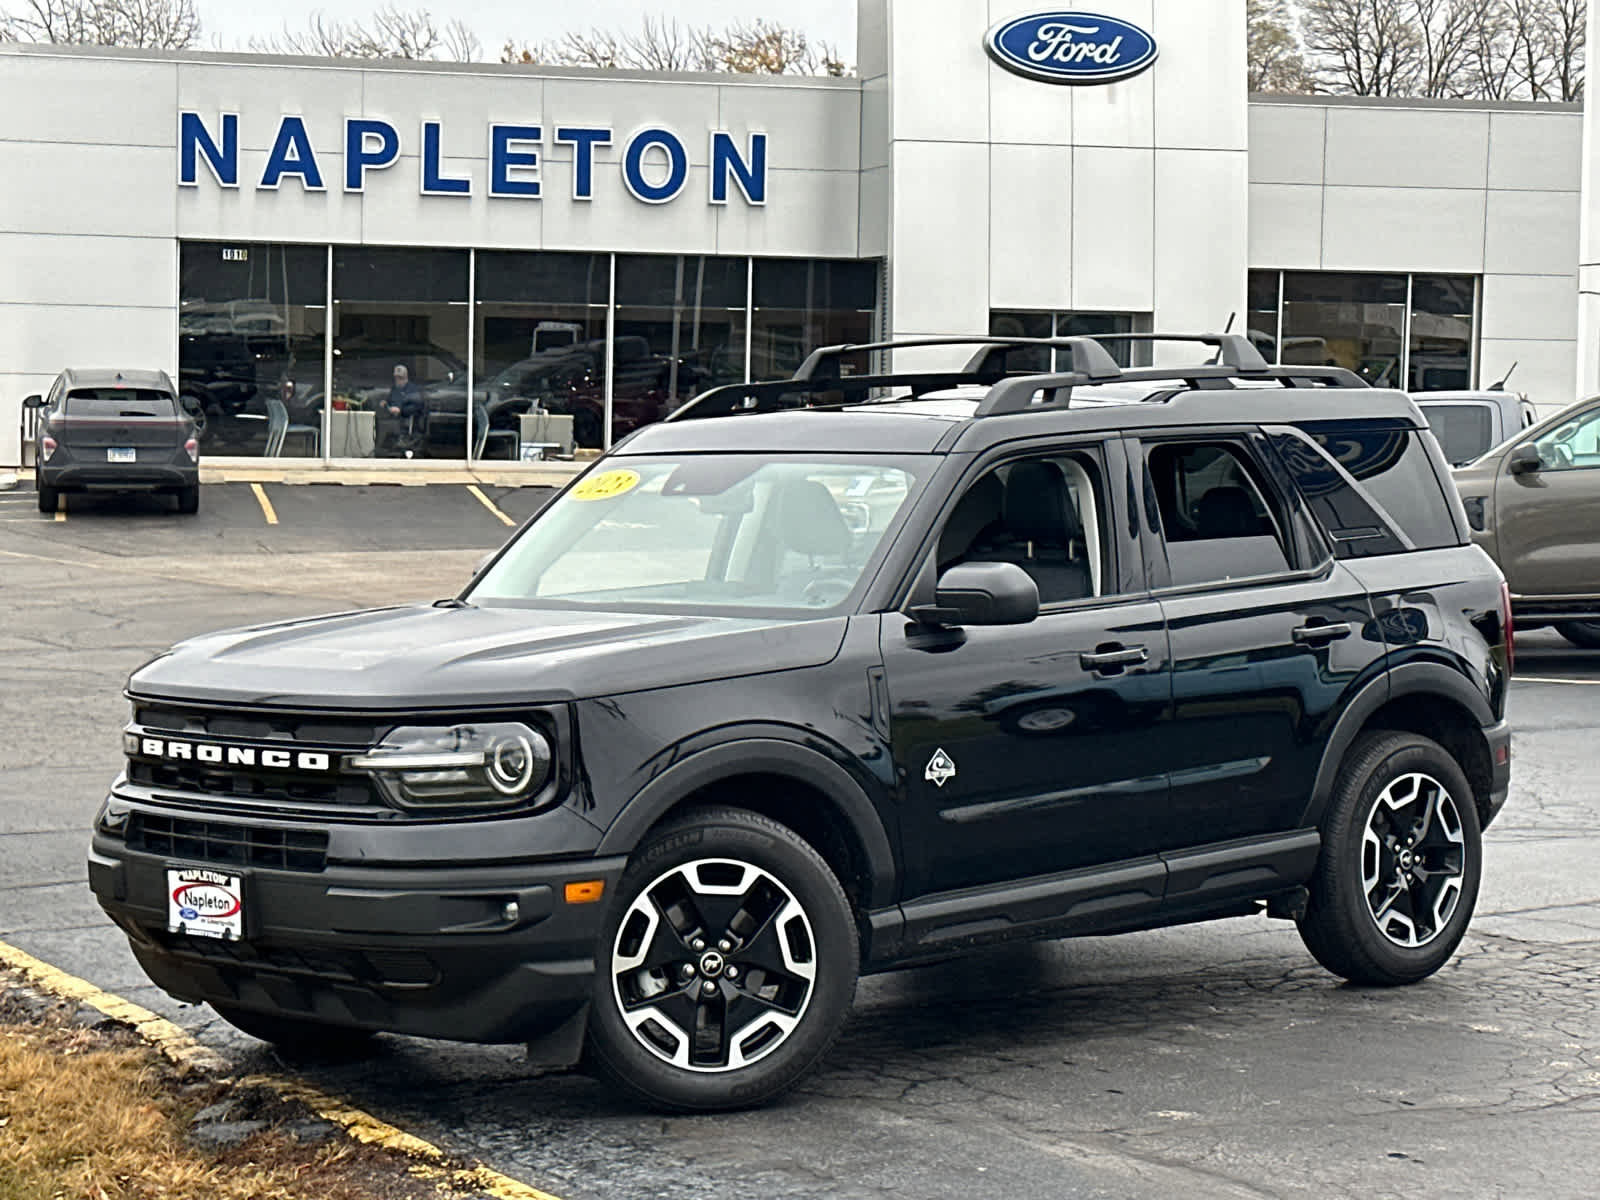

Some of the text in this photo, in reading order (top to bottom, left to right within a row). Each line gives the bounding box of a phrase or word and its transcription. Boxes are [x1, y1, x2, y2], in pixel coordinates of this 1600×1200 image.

[1027, 22, 1124, 64] Ford
[178, 111, 768, 206] NAPLETON
[142, 738, 329, 770] BRONCO
[184, 889, 230, 911] Napleton
